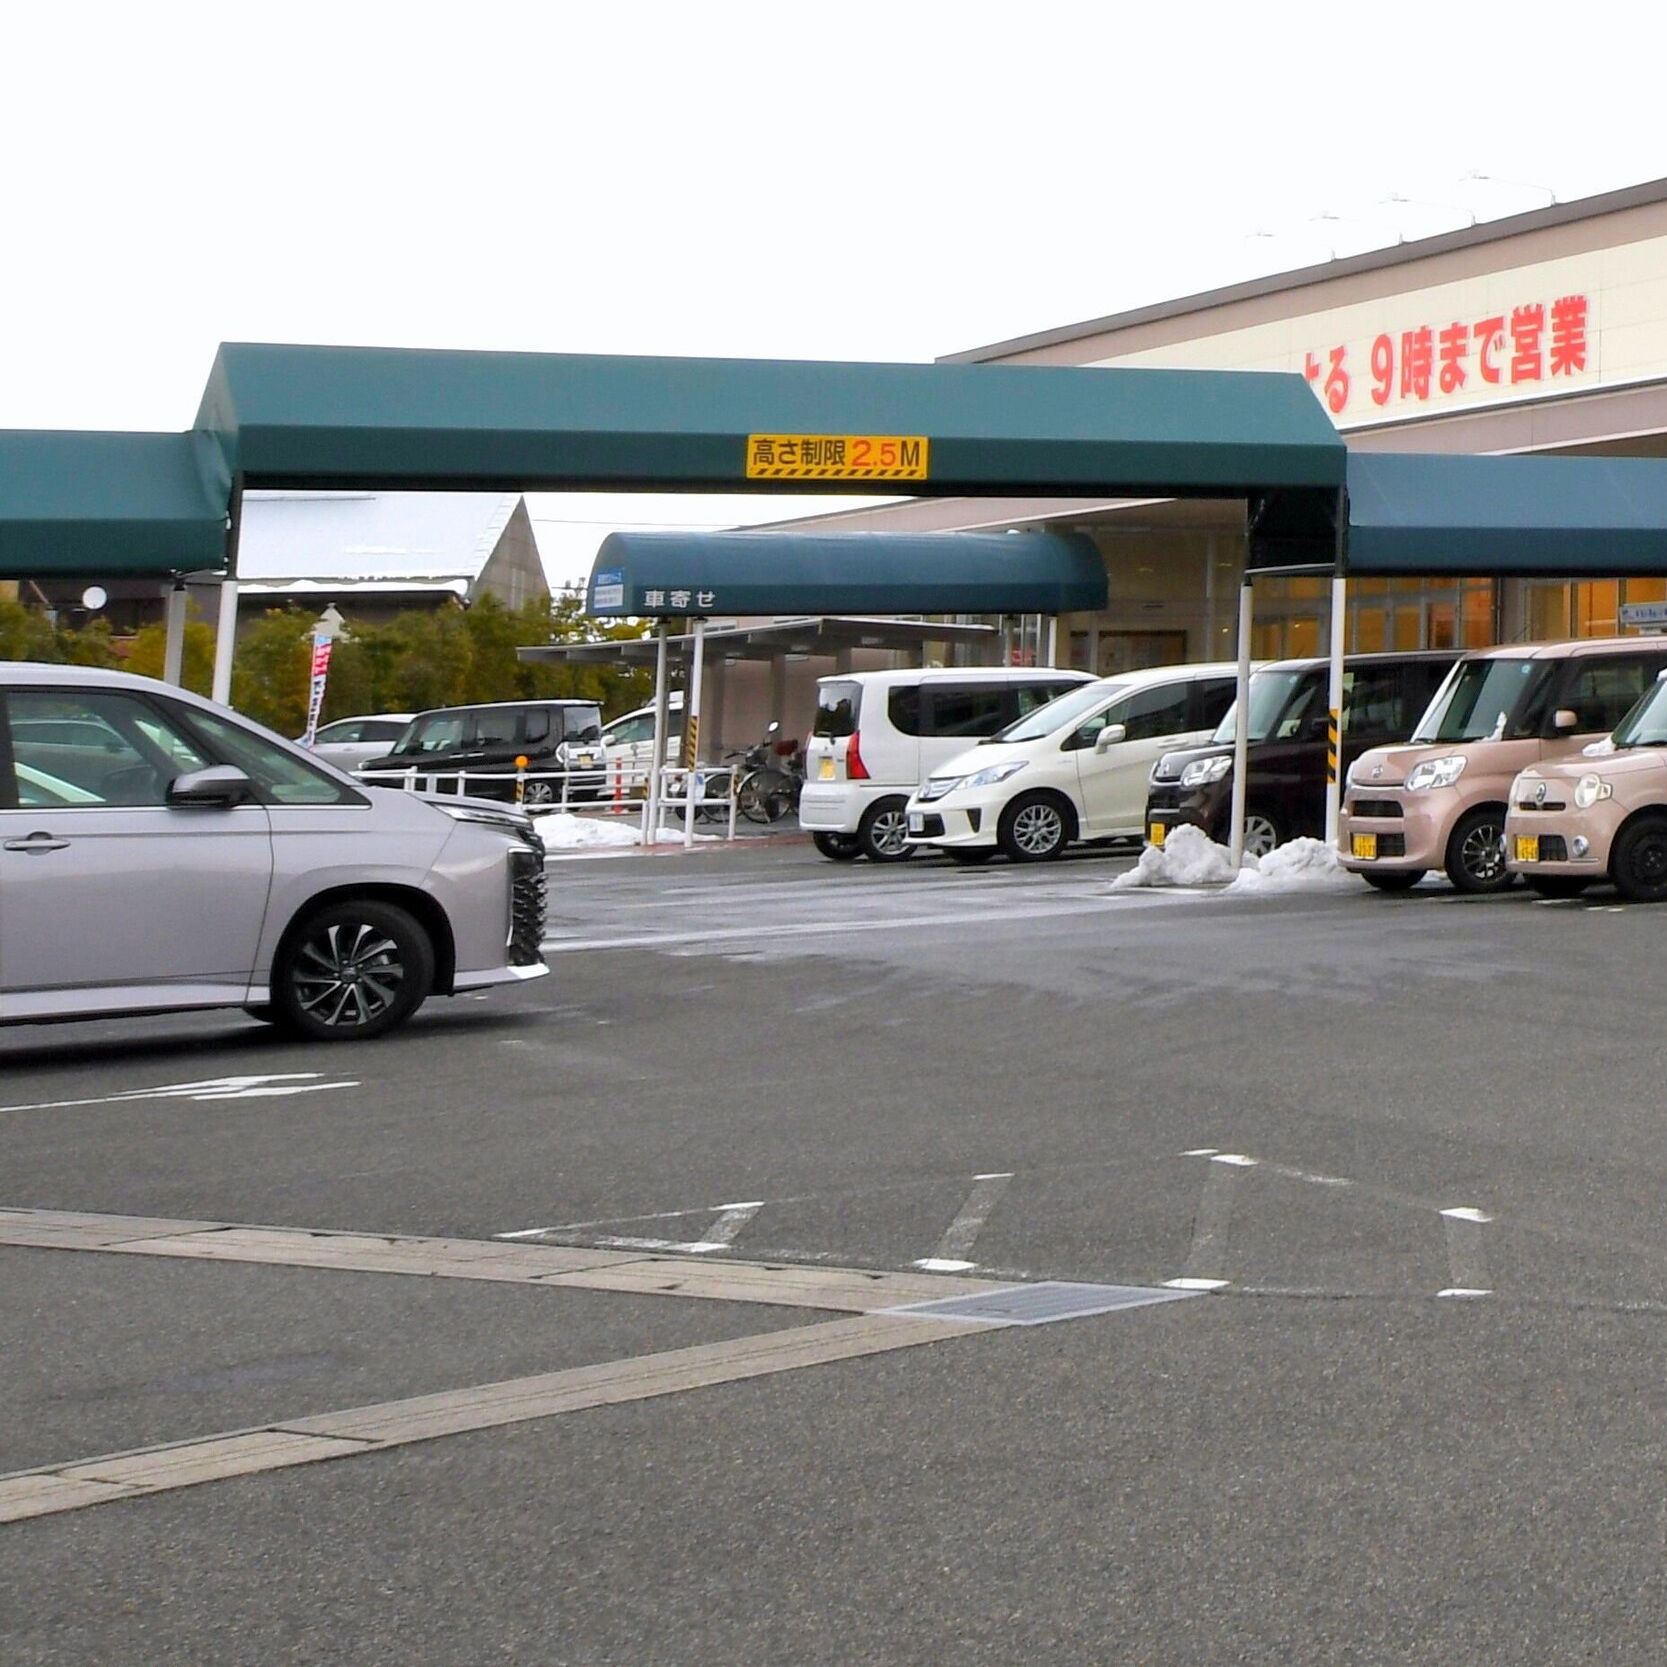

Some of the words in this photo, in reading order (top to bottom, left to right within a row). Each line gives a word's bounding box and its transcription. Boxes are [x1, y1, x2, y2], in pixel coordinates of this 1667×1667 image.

[1370, 294, 1588, 406] 9時まで営業
[753, 439, 845, 467] 高さ制限
[643, 589, 716, 608] 車寄せ
